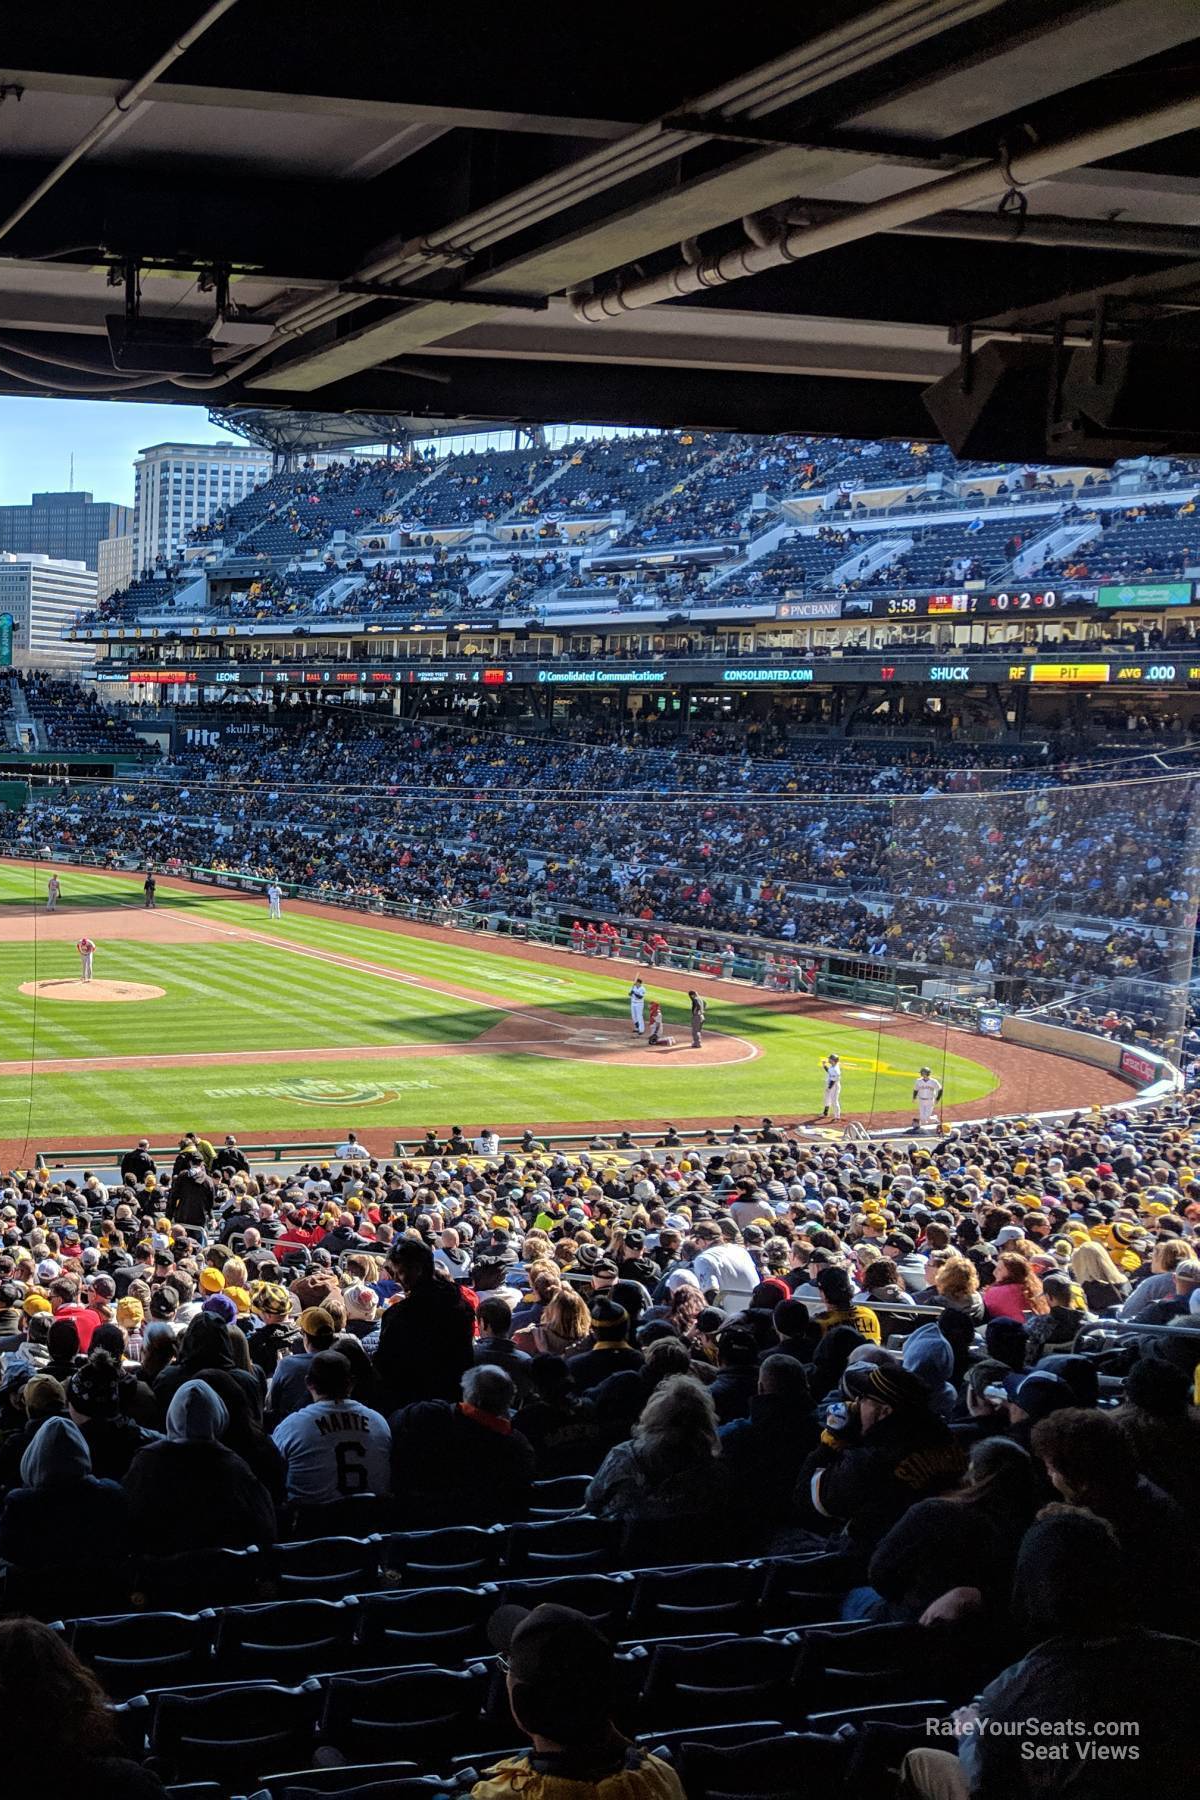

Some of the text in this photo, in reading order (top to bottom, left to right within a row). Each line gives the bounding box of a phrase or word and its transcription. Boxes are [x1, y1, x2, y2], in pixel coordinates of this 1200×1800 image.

[888, 599, 916, 613] 3:58
[935, 596, 948, 604] STL
[997, 593, 1008, 609] 0
[1020, 592, 1031, 608] 2
[1044, 591, 1055, 607] 0
[216, 672, 240, 681] LEONE
[276, 673, 289, 681] STL
[306, 673, 321, 681] BALL
[324, 672, 330, 681] 0
[336, 673, 358, 681] STRIKE
[361, 672, 367, 681] 3
[395, 672, 401, 681] 3
[472, 672, 479, 681] 4
[506, 671, 513, 681] 3
[547, 670, 665, 681] Consolidated Communications
[724, 669, 812, 681] CONSOLIDATED.COM
[880, 668, 895, 680] 17
[930, 667, 969, 680] SHUCK
[1009, 667, 1026, 680] RF
[1060, 668, 1079, 679] PIT
[1118, 668, 1142, 679] AVG
[1145, 666, 1176, 680] .000
[225, 723, 250, 734] skull
[186, 728, 220, 749] lite
[1122, 1052, 1141, 1071] Great
[315, 1413, 370, 1436] MARTE
[334, 1440, 368, 1494] 6
